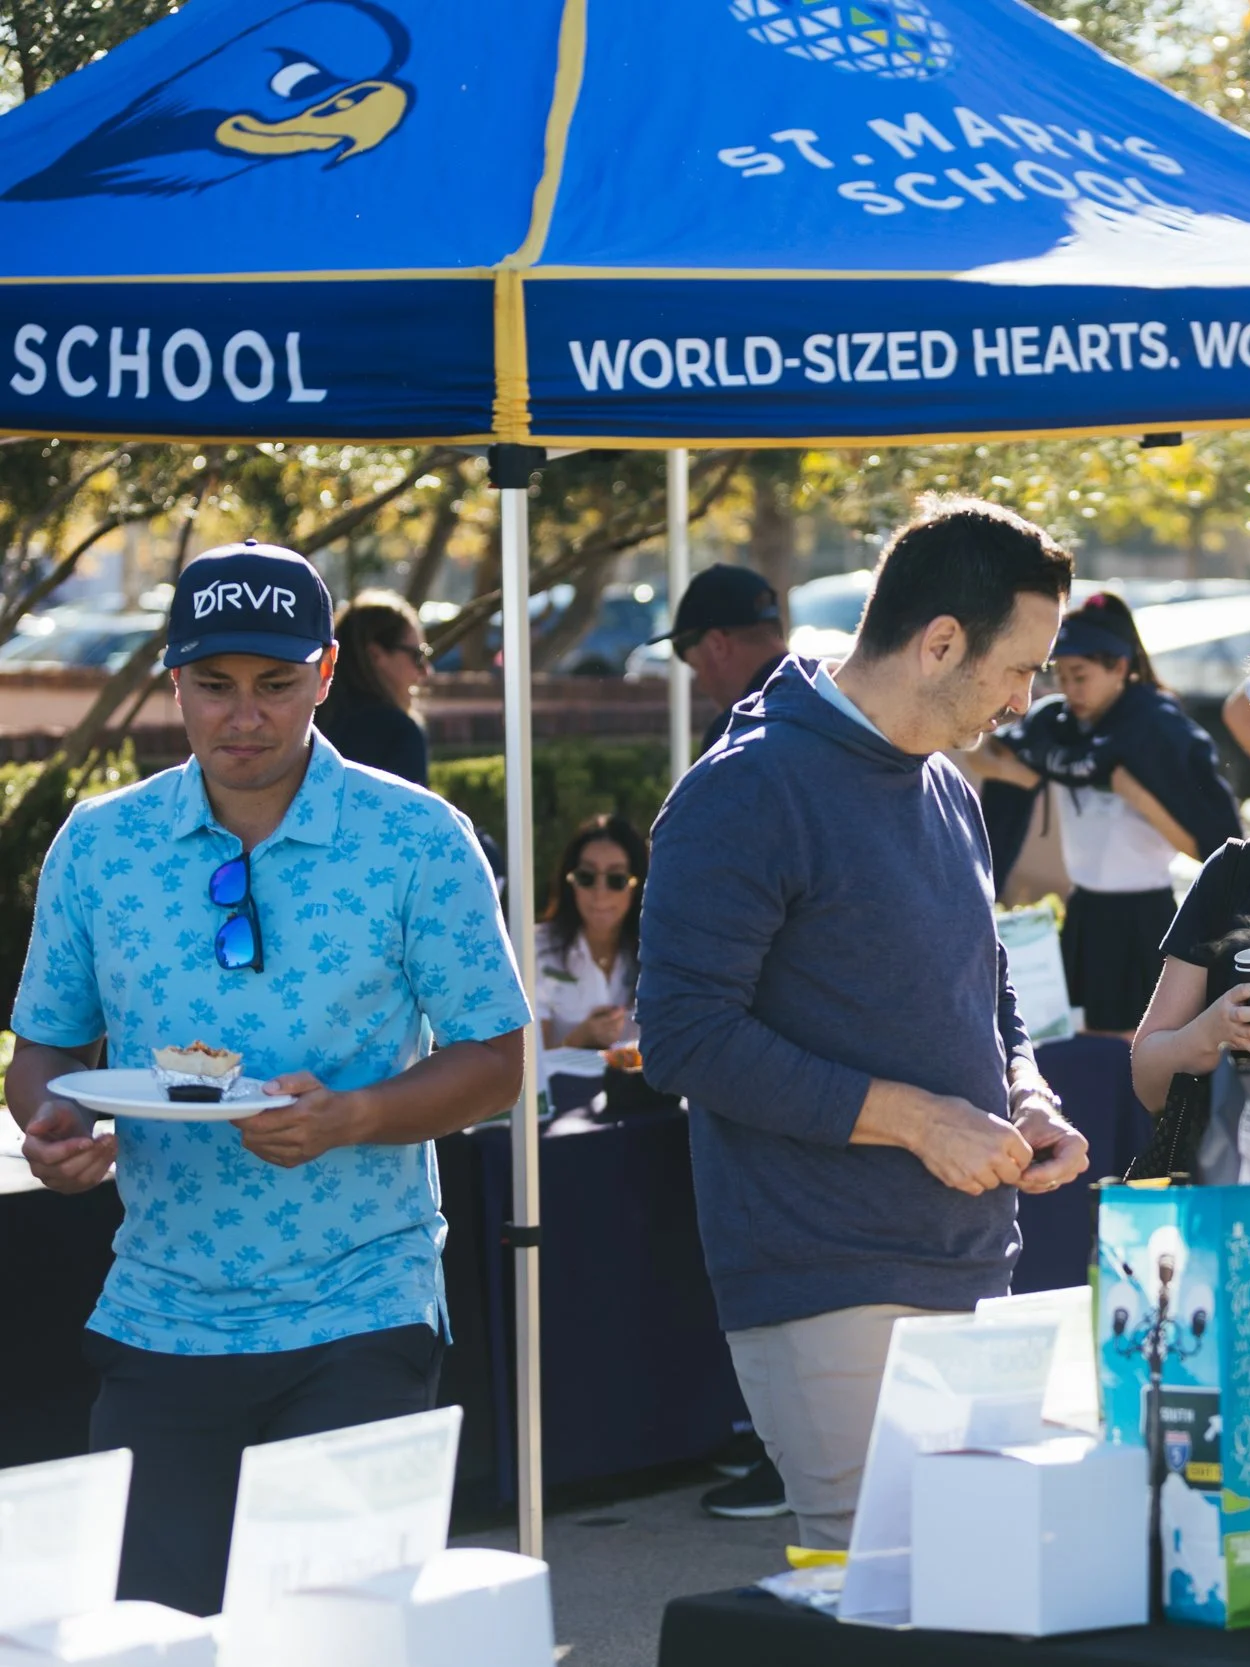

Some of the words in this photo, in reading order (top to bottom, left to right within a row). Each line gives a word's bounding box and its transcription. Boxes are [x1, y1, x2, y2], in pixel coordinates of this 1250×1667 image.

[717, 129, 874, 177] ST.
[867, 107, 1185, 176] MARY'S
[9, 323, 328, 404] SCHOOL
[568, 329, 958, 392] WORLD-SIZED
[973, 321, 1181, 377] HEARTS.
[193, 579, 297, 620] DRVR
